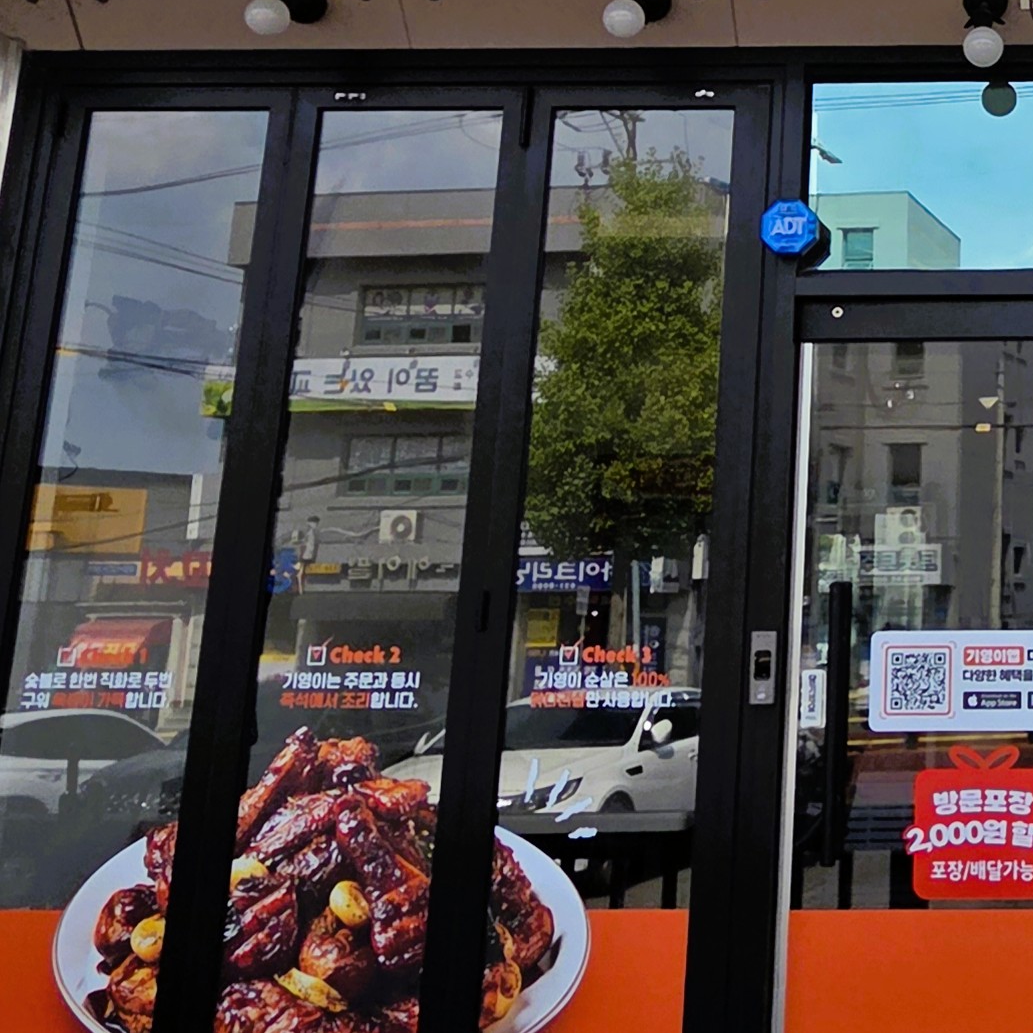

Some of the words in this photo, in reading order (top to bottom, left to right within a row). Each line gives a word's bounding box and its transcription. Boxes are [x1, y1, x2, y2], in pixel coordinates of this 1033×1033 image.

[770, 216, 807, 236] ADT
[330, 645, 385, 664] Check
[389, 646, 401, 664] 2
[582, 645, 637, 663] Check
[641, 646, 652, 663] 3
[282, 671, 342, 689] 기영이는
[343, 671, 389, 689] 주문과
[539, 671, 582, 689] 기영이
[962, 669, 997, 682] 다양한
[905, 819, 1008, 854] 2,000원
